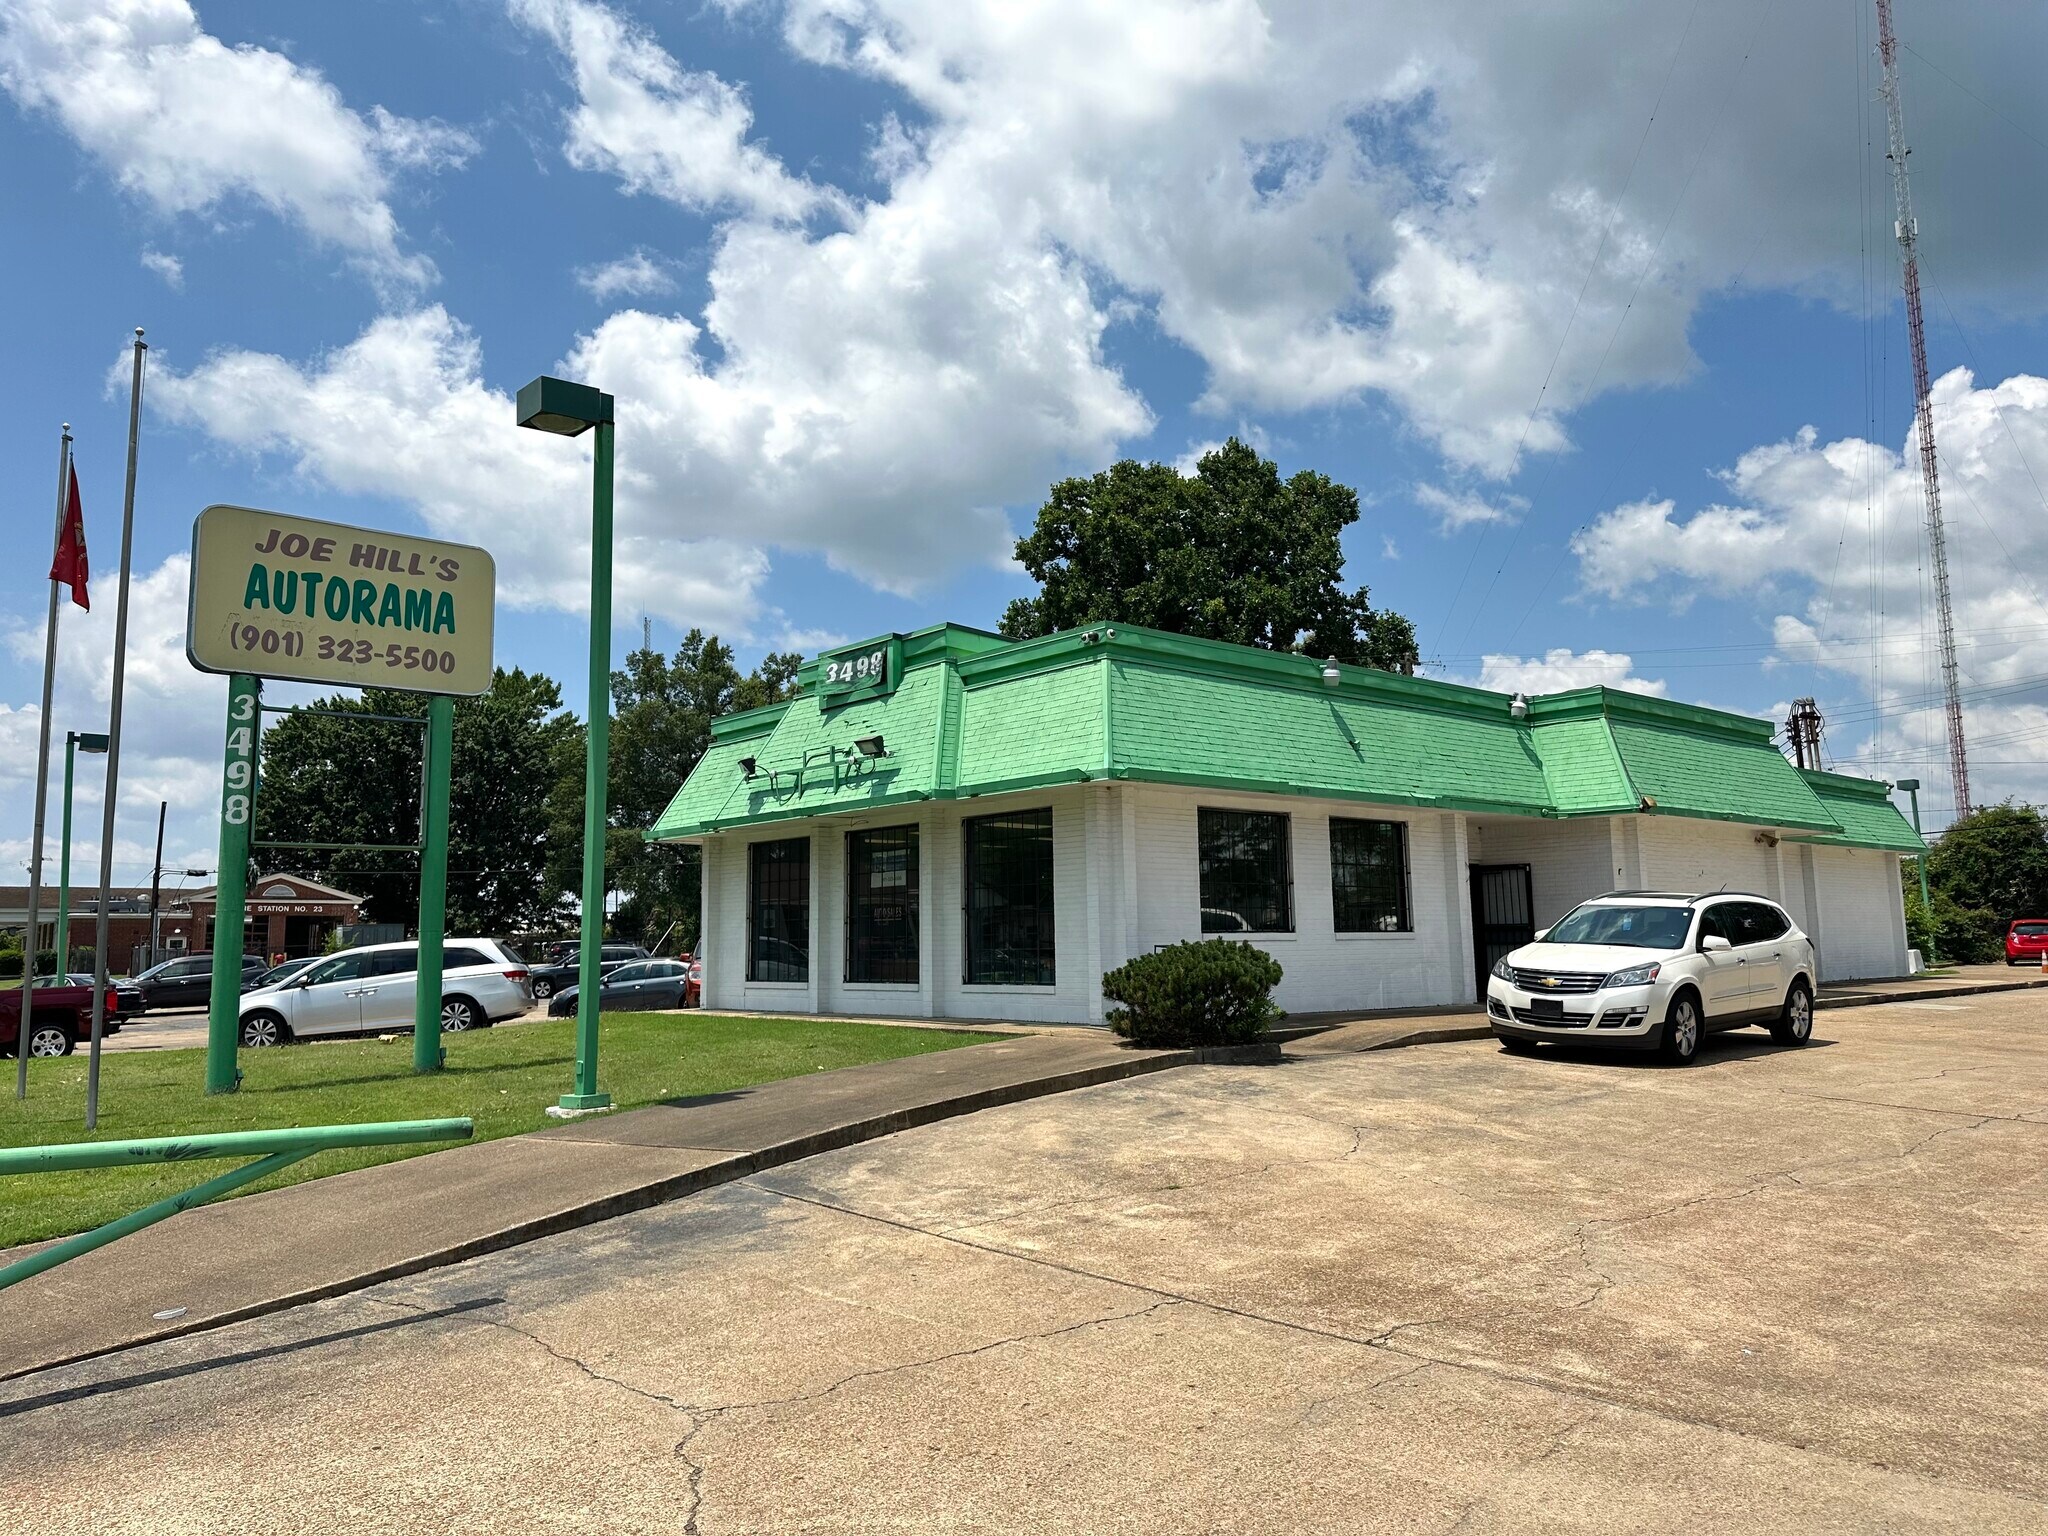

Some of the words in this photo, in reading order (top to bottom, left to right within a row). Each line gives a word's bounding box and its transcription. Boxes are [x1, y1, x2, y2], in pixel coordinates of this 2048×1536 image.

[255, 529, 337, 562] JOE
[349, 543, 460, 582] HILL'S
[243, 562, 456, 635] AUTORAMA
[230, 621, 304, 658] (901)
[317, 635, 456, 675] 323-5500
[826, 651, 883, 684] 3498
[225, 694, 255, 825] 3498
[294, 905, 308, 913] NO.
[313, 905, 323, 913] 23
